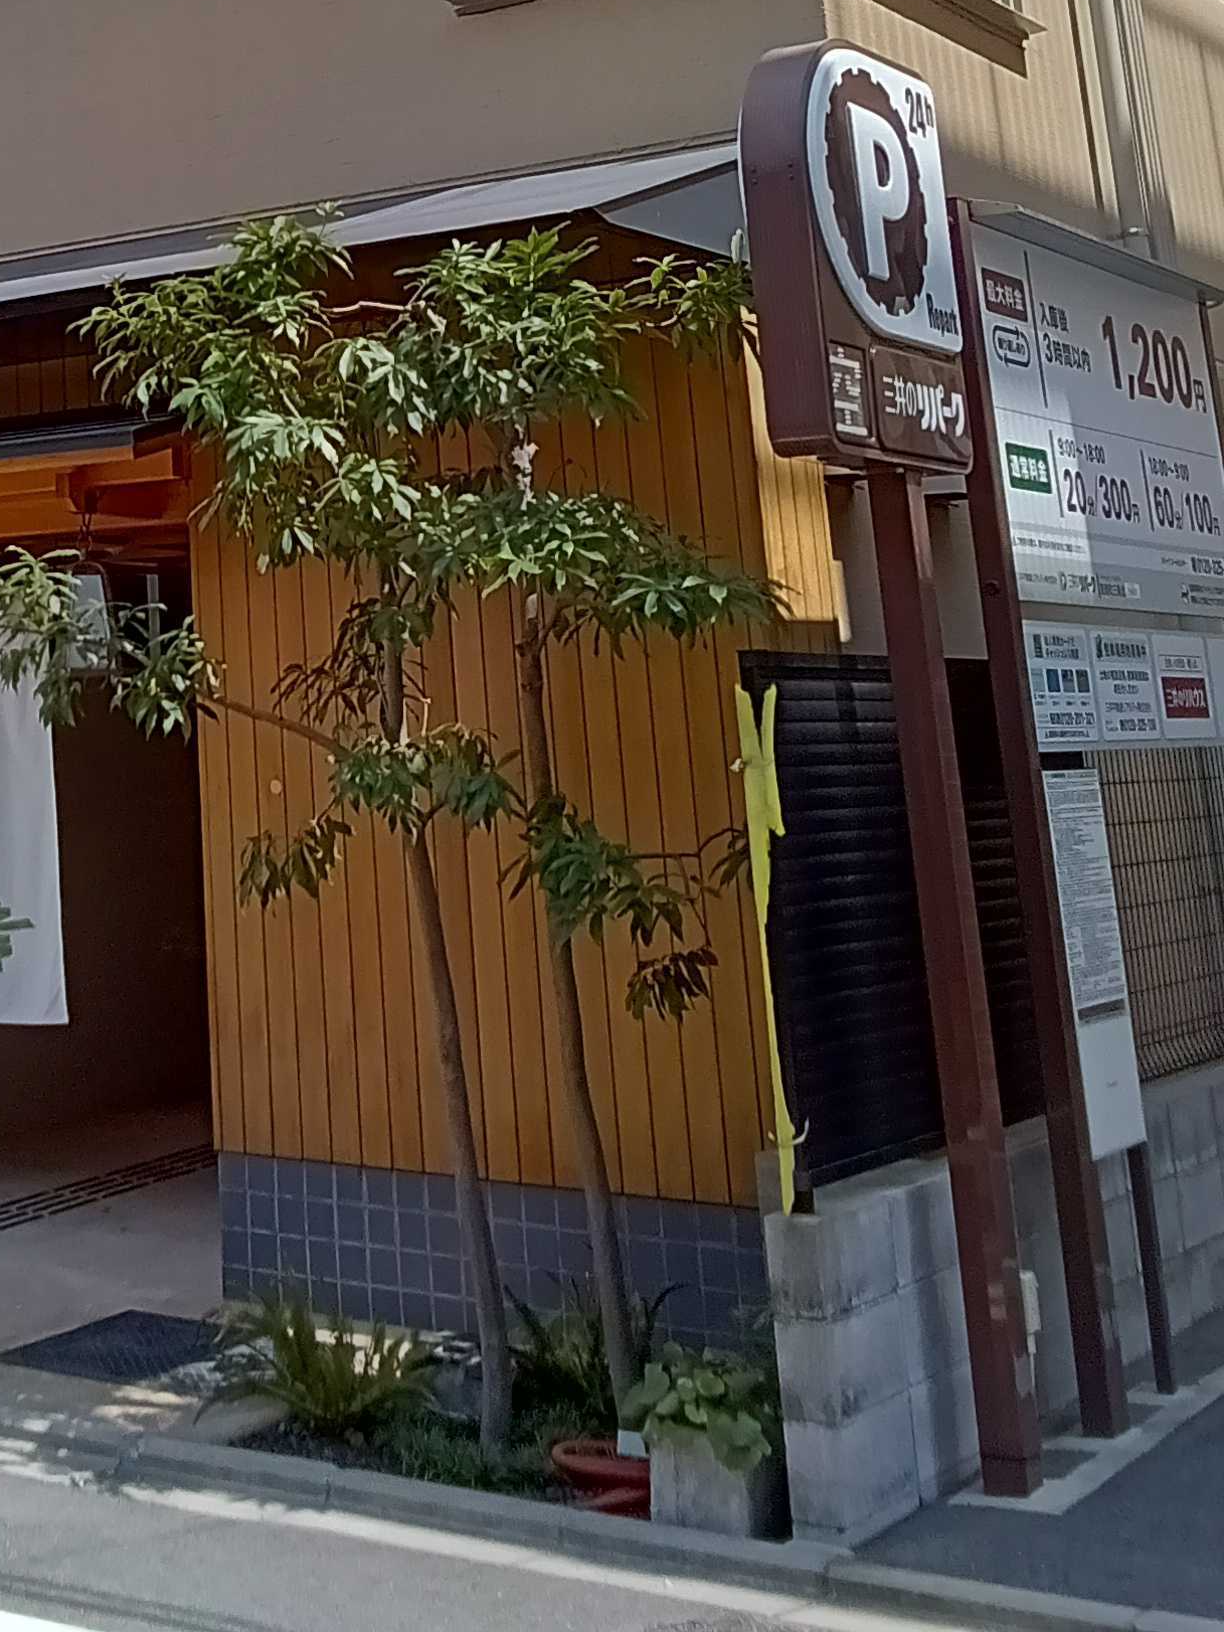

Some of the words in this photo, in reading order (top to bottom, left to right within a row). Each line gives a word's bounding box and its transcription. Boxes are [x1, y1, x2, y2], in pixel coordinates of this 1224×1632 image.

[905, 86, 934, 138] 24h
[846, 101, 910, 282] P
[985, 279, 1025, 312] 最大料金
[1039, 302, 1069, 334] 入庫後
[1042, 332, 1092, 373] 3時間以内
[1102, 314, 1207, 414] 1,200円
[883, 375, 966, 437] 三井のリパーク
[1009, 455, 1049, 483] 通常料金
